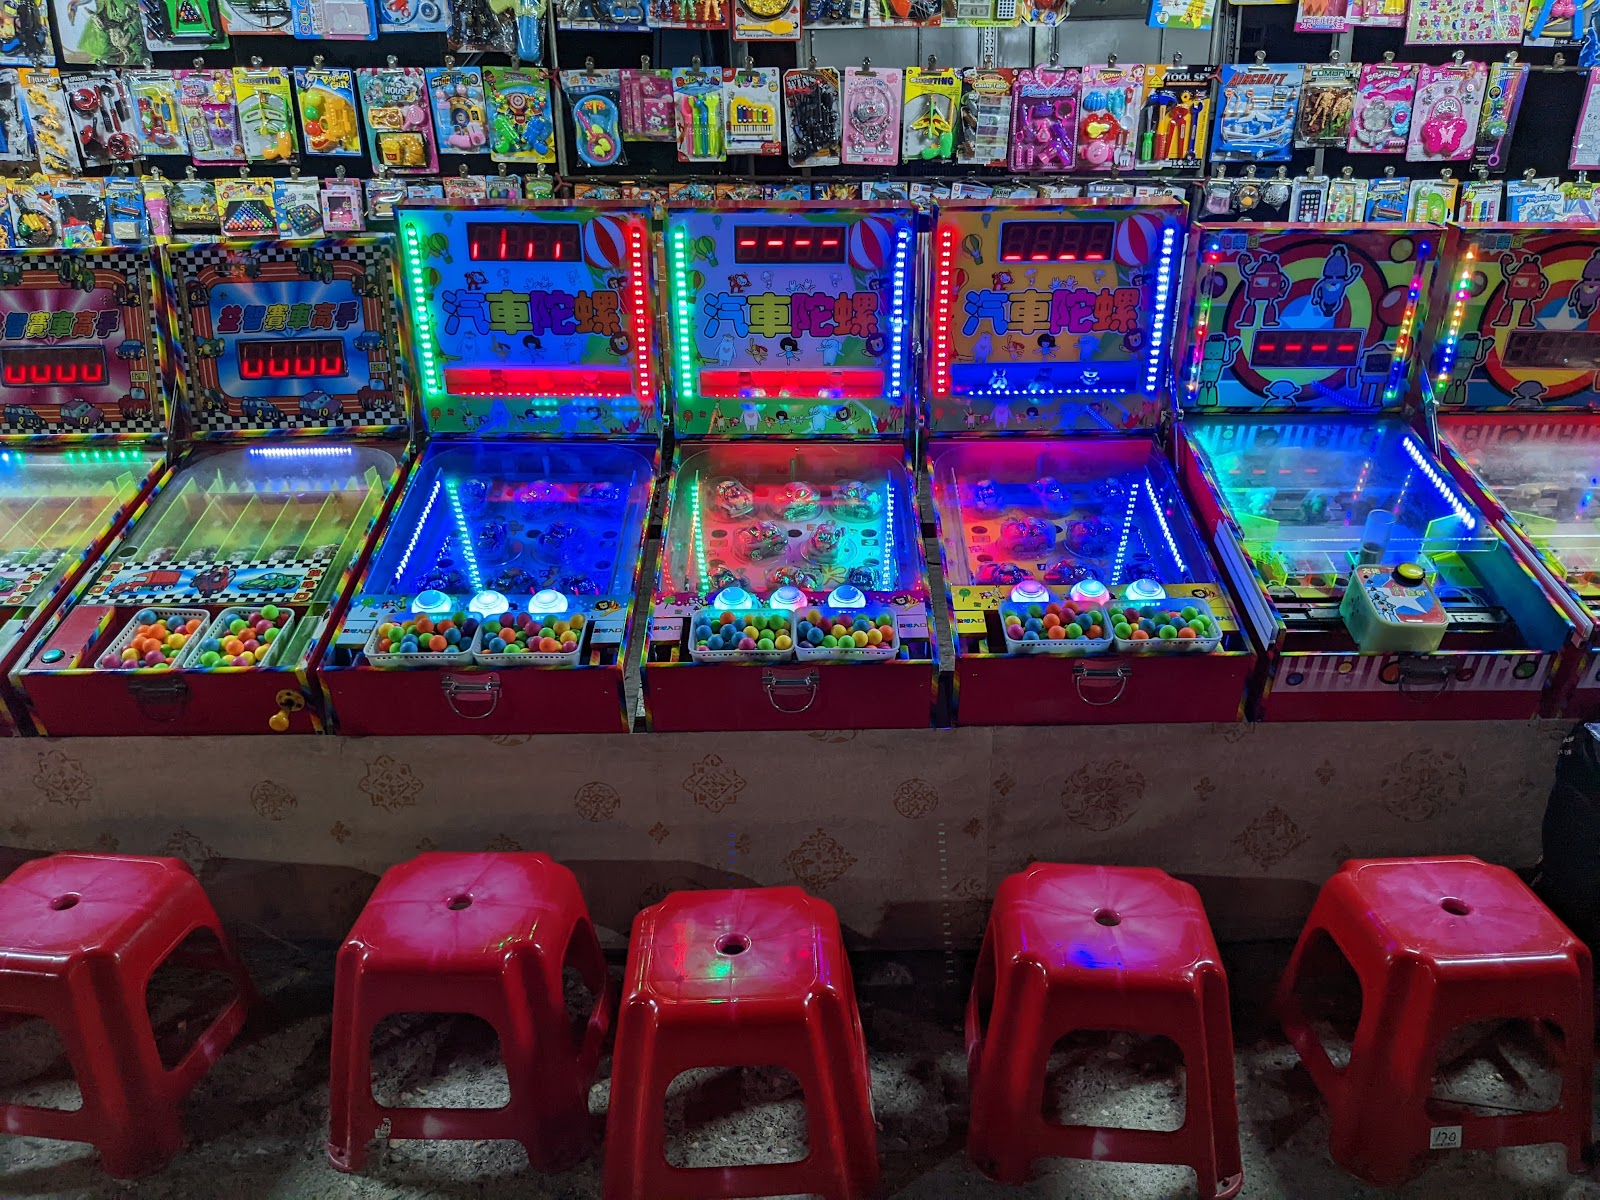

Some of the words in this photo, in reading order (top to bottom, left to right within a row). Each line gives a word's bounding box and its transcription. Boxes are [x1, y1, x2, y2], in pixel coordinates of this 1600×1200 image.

[1166, 72, 1190, 82] TOOL
[1226, 73, 1288, 86] AIRCRAFT
[385, 86, 410, 95] HOUSE
[217, 301, 358, 333] 益智賽車高手
[442, 289, 621, 336] 汽車陀螺
[704, 292, 878, 338] 汽車陀螺
[962, 288, 1141, 336] 汽車陀螺
[0, 310, 120, 339] 智賽車高手
[79, 416, 90, 425] 10
[318, 408, 329, 418] 10
